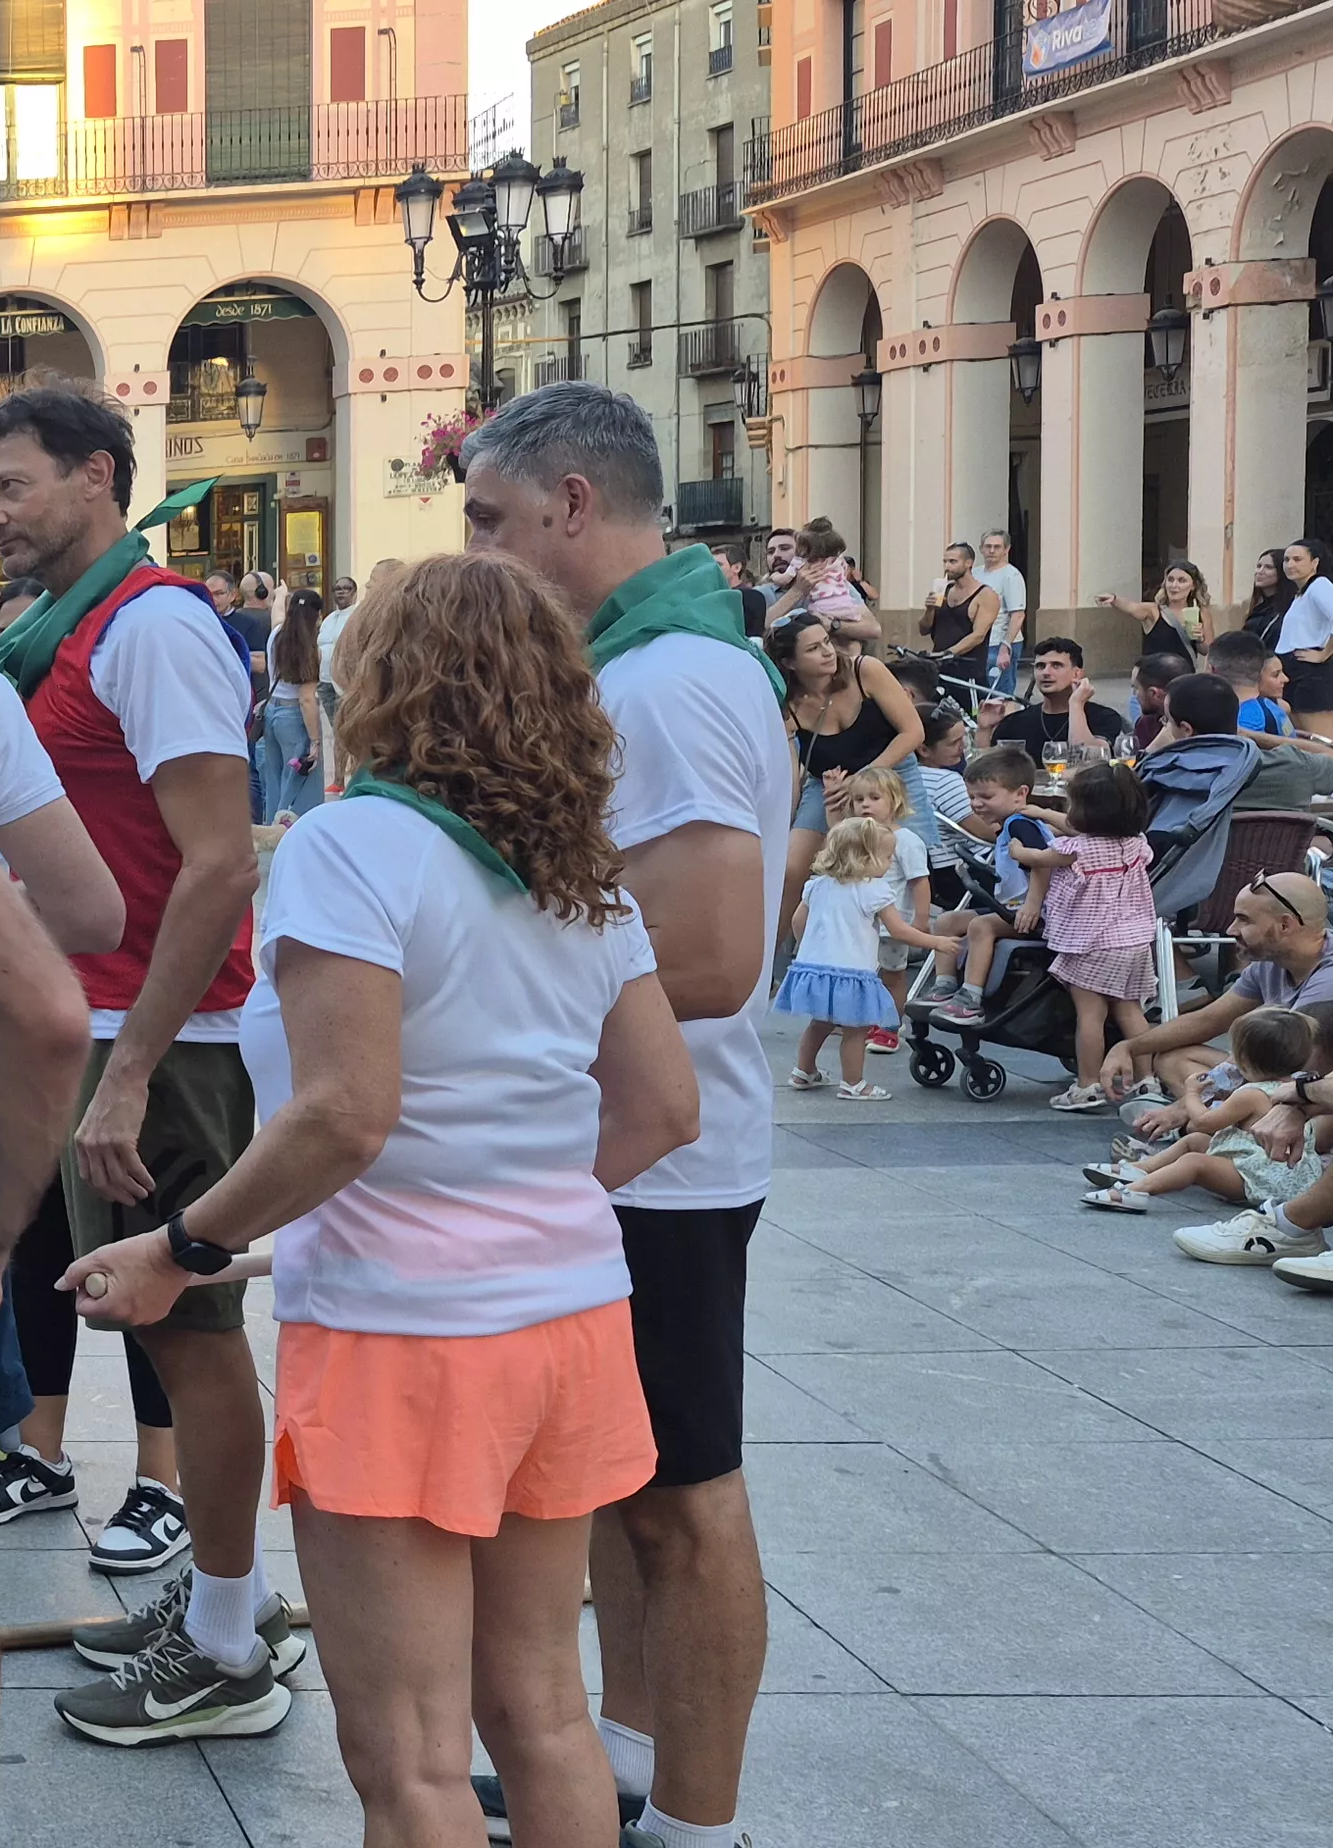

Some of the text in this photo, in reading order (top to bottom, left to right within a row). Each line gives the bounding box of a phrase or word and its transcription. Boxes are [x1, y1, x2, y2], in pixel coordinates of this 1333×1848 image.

[215, 303, 272, 318] desde 1871
[15, 315, 65, 333] CONFIANZA
